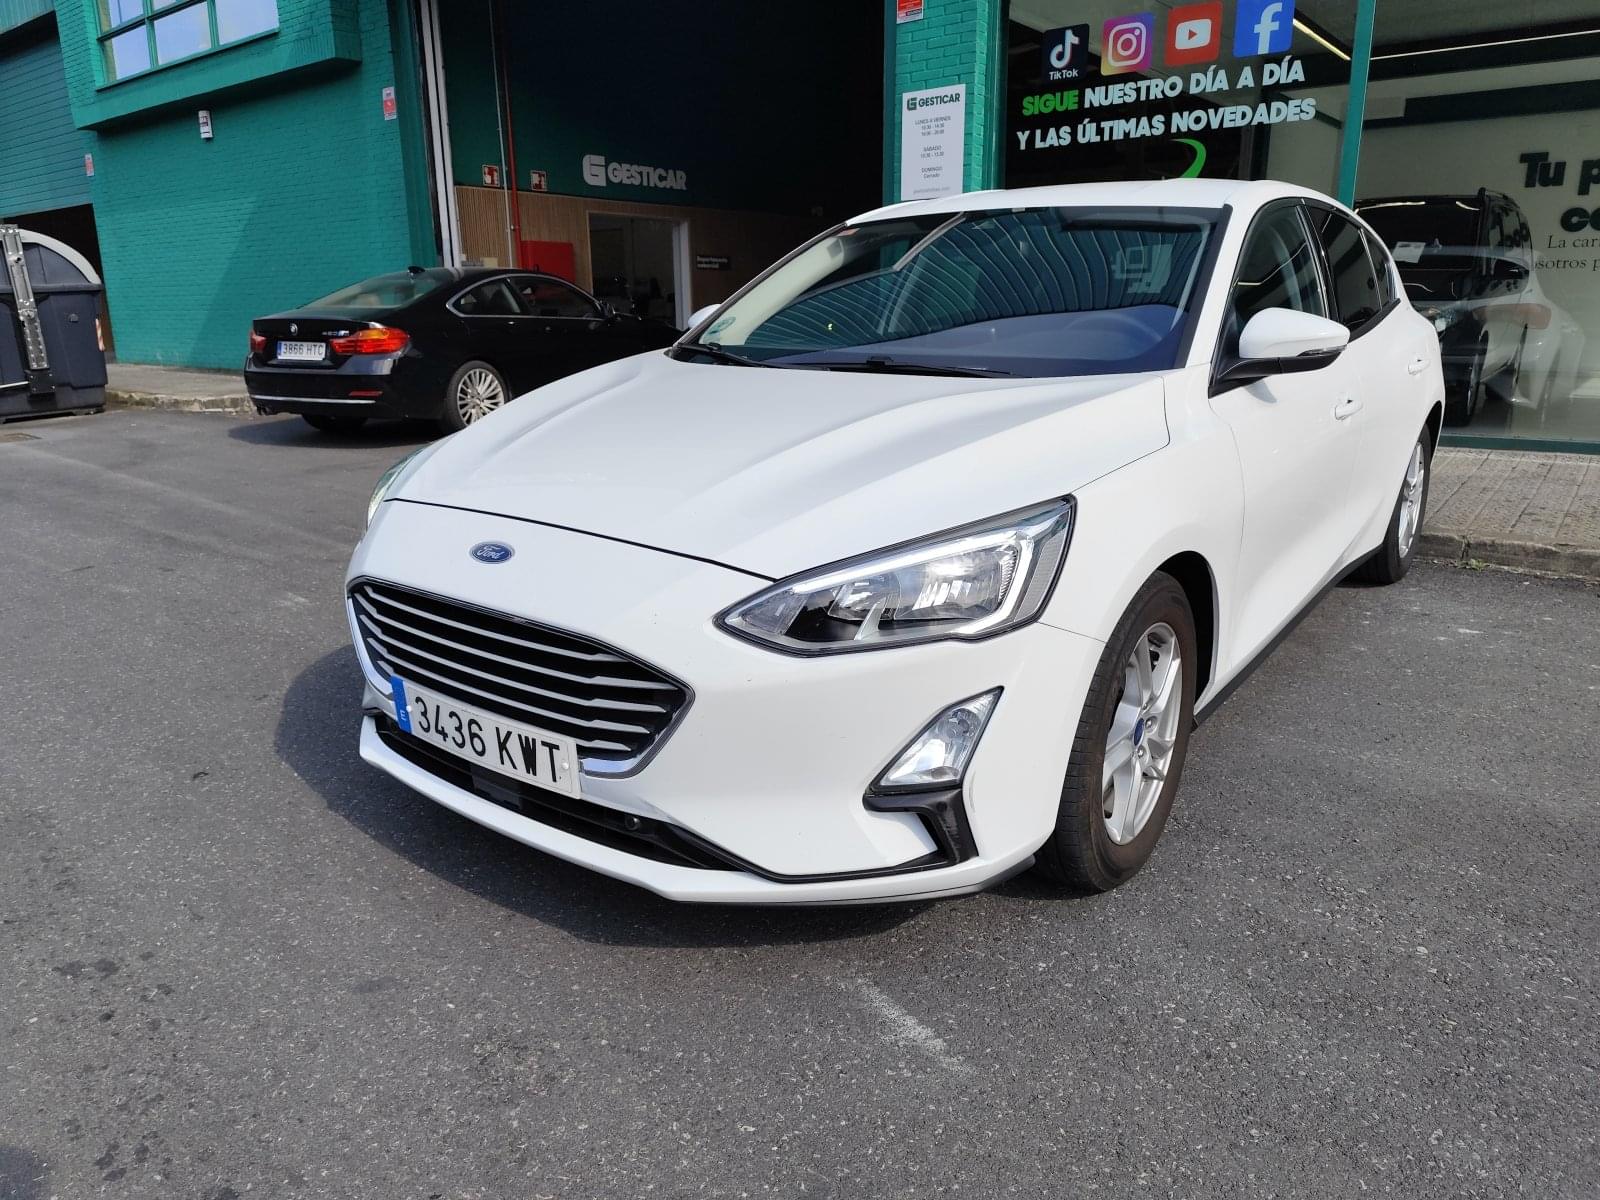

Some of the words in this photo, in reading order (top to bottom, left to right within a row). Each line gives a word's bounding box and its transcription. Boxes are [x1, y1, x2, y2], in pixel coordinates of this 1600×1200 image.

[1022, 90, 1079, 116] SIGUE
[1084, 76, 1183, 108] NUESTRO
[1190, 65, 1229, 94] DÍA
[1237, 66, 1255, 89] A
[1263, 55, 1305, 86] DÍA
[1049, 68, 1079, 80] TikTok
[918, 93, 961, 108] GESTICAR
[1016, 130, 1030, 150] Y
[1034, 126, 1071, 149] LAS
[1077, 114, 1165, 144] ÚLTIMAS
[1171, 98, 1316, 133] NOVEDADES
[607, 162, 687, 190] GESTICAR
[1520, 151, 1567, 188] Tu
[1547, 234, 1567, 249] La
[306, 344, 324, 356] HTC
[415, 696, 486, 758] 3436
[495, 726, 560, 783] KWT
